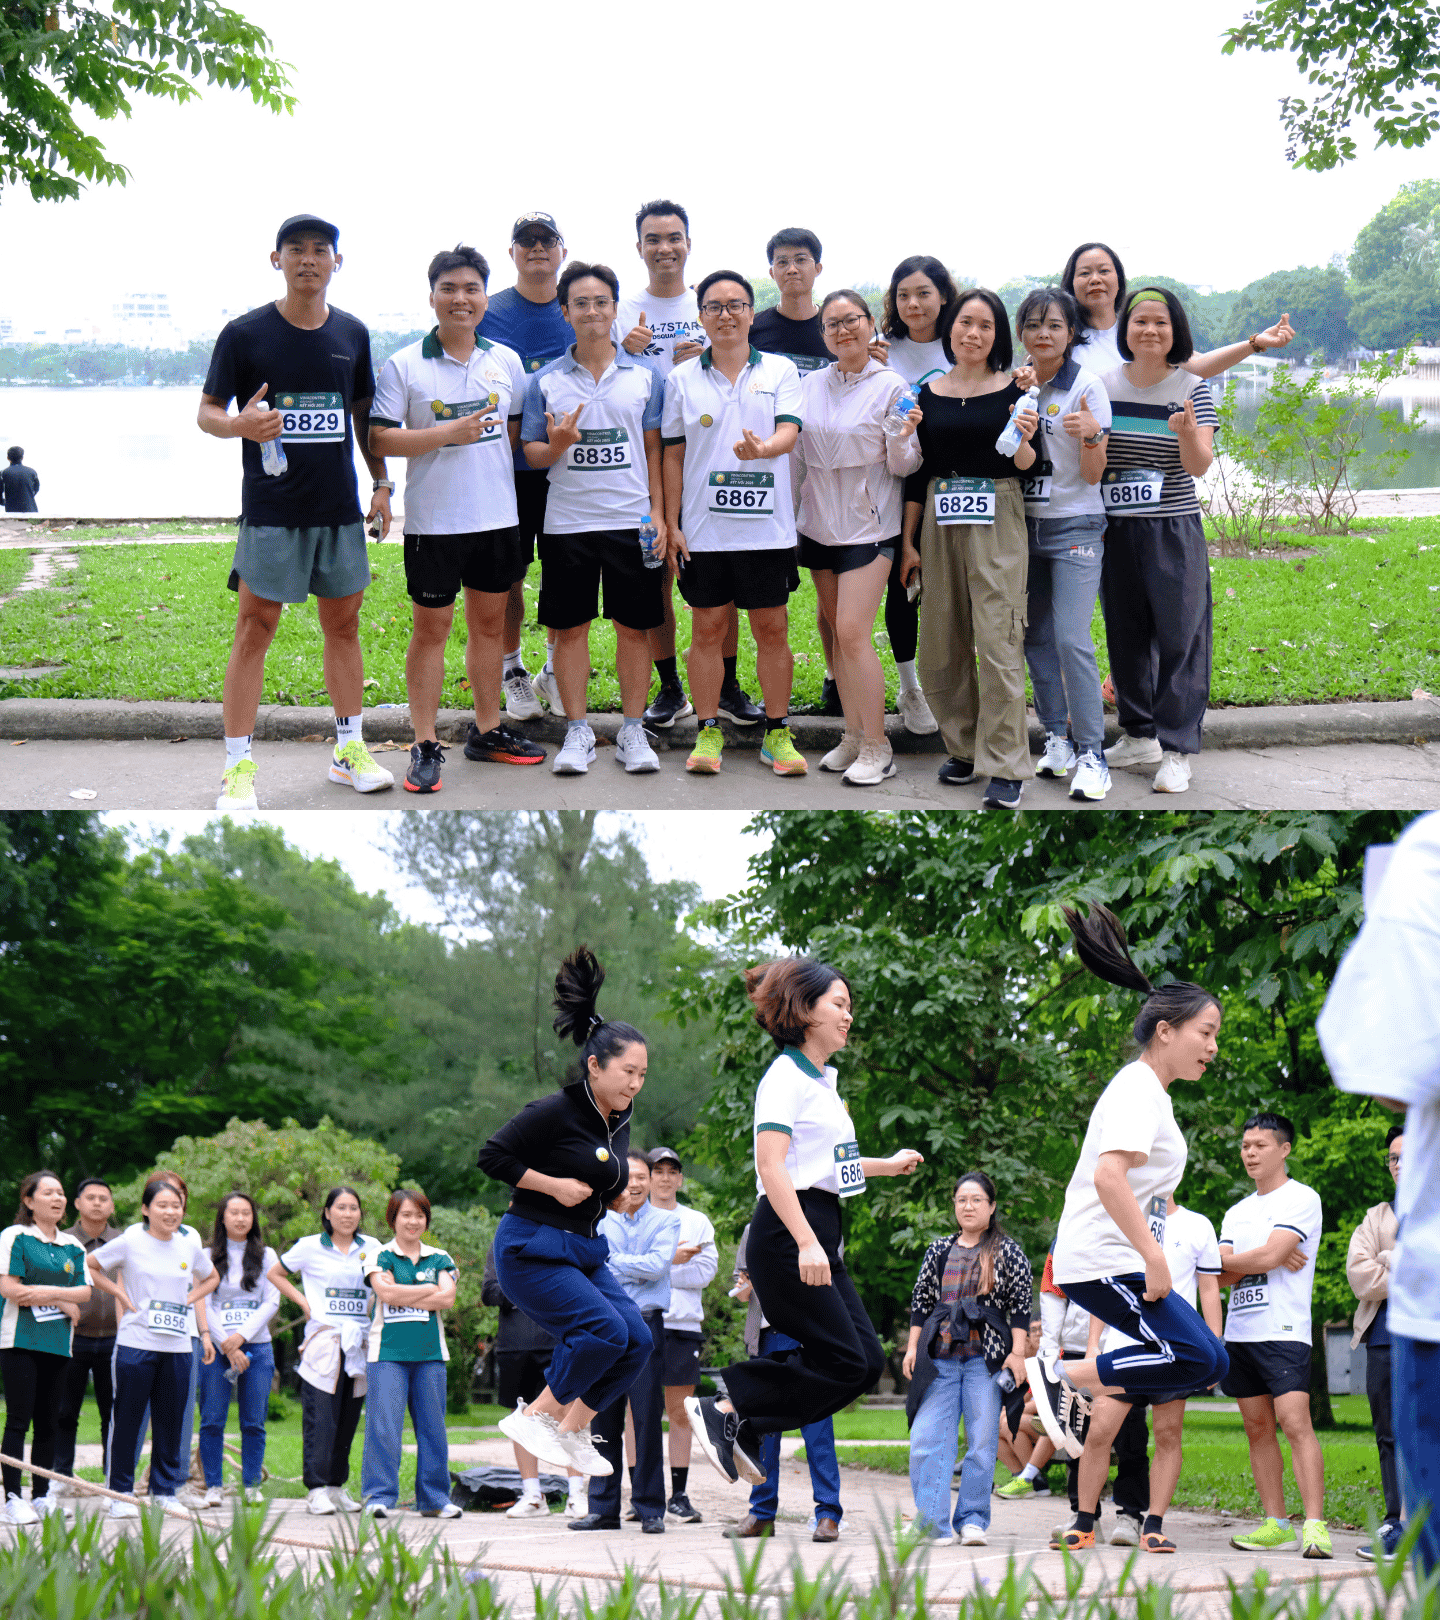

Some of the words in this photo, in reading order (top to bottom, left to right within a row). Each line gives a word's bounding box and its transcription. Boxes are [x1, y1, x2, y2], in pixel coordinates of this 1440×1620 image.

[283, 413, 339, 431] 6829
[573, 446, 625, 464] 6835
[715, 489, 768, 507] 6867
[1110, 484, 1152, 504] 6816
[939, 496, 988, 514] 6825
[1070, 545, 1095, 558] FILA
[841, 1162, 864, 1184] 686
[329, 1300, 364, 1312] 6809
[1233, 1288, 1264, 1306] 6865
[153, 1313, 185, 1329] 6856
[225, 1311, 254, 1322] 683
